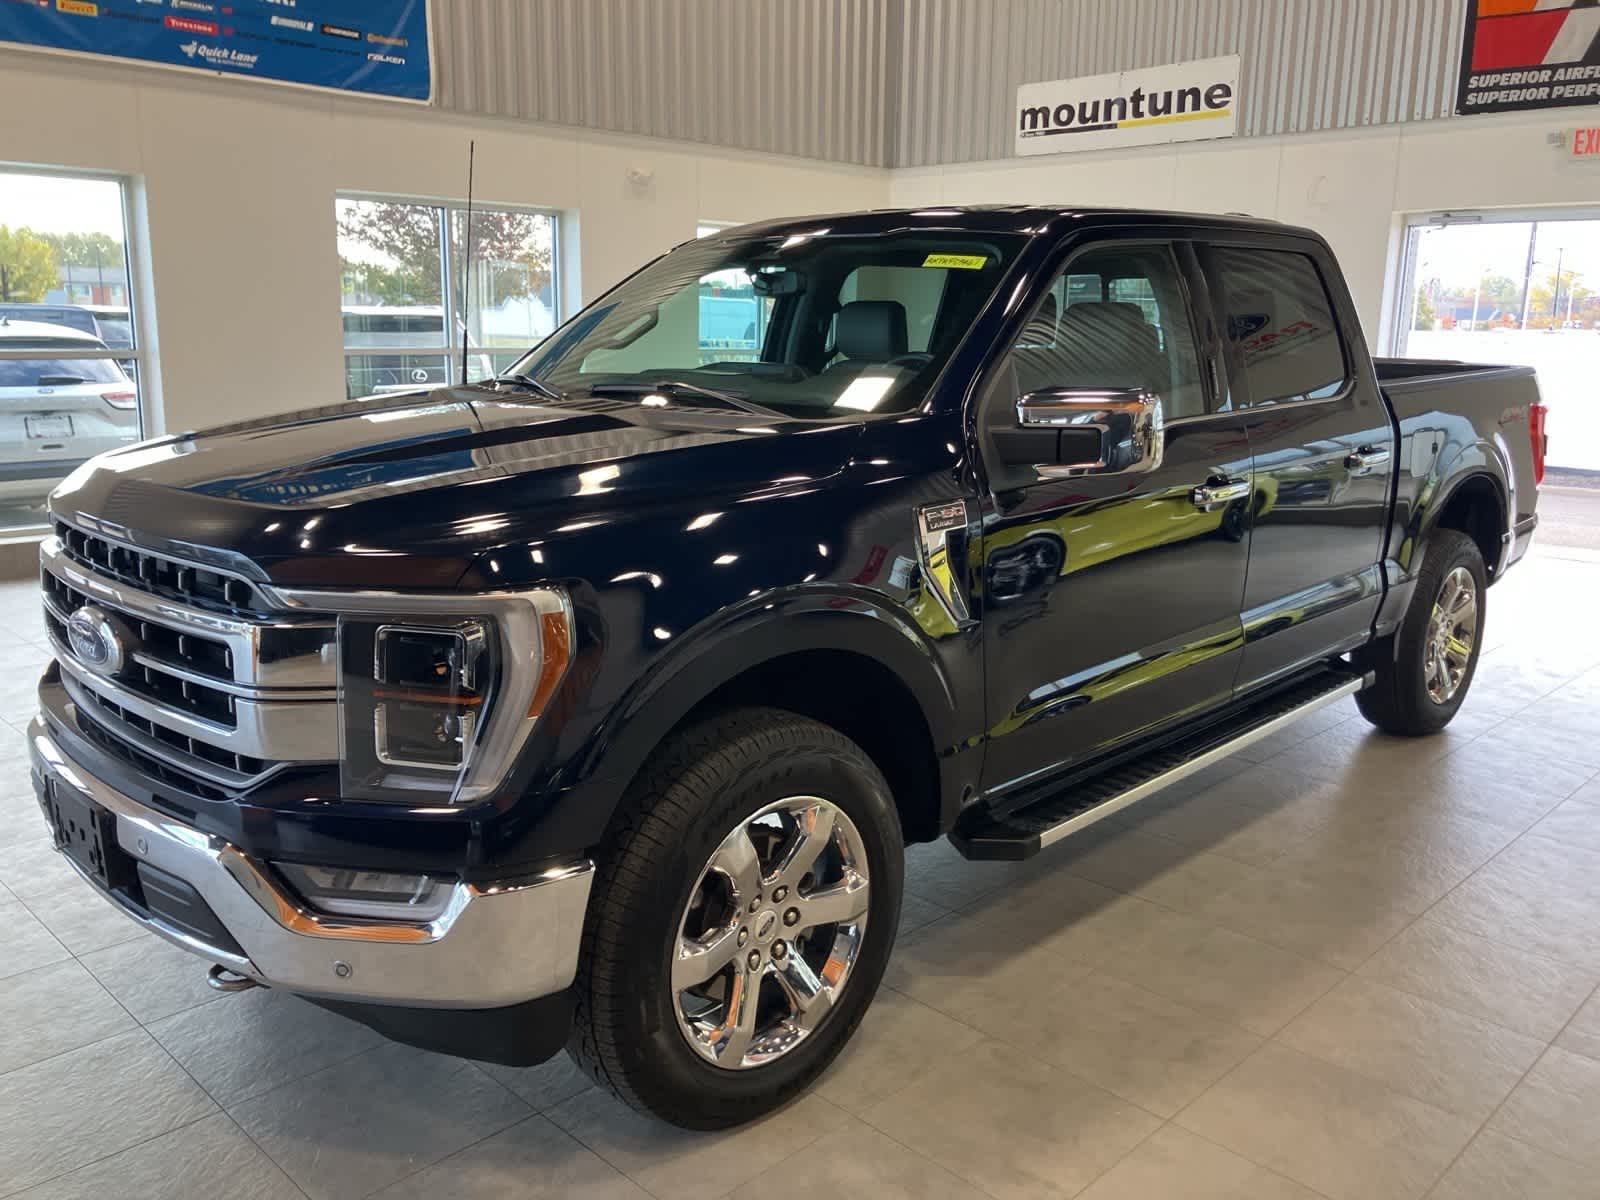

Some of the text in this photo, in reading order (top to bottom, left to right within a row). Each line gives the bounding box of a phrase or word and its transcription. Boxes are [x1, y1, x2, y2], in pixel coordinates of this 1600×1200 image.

[198, 44, 230, 58] Quick
[230, 49, 258, 62] Lane
[1468, 70, 1551, 89] SUPERIOR
[1466, 87, 1550, 105] SUPERIOR
[1020, 83, 1232, 130] mountune
